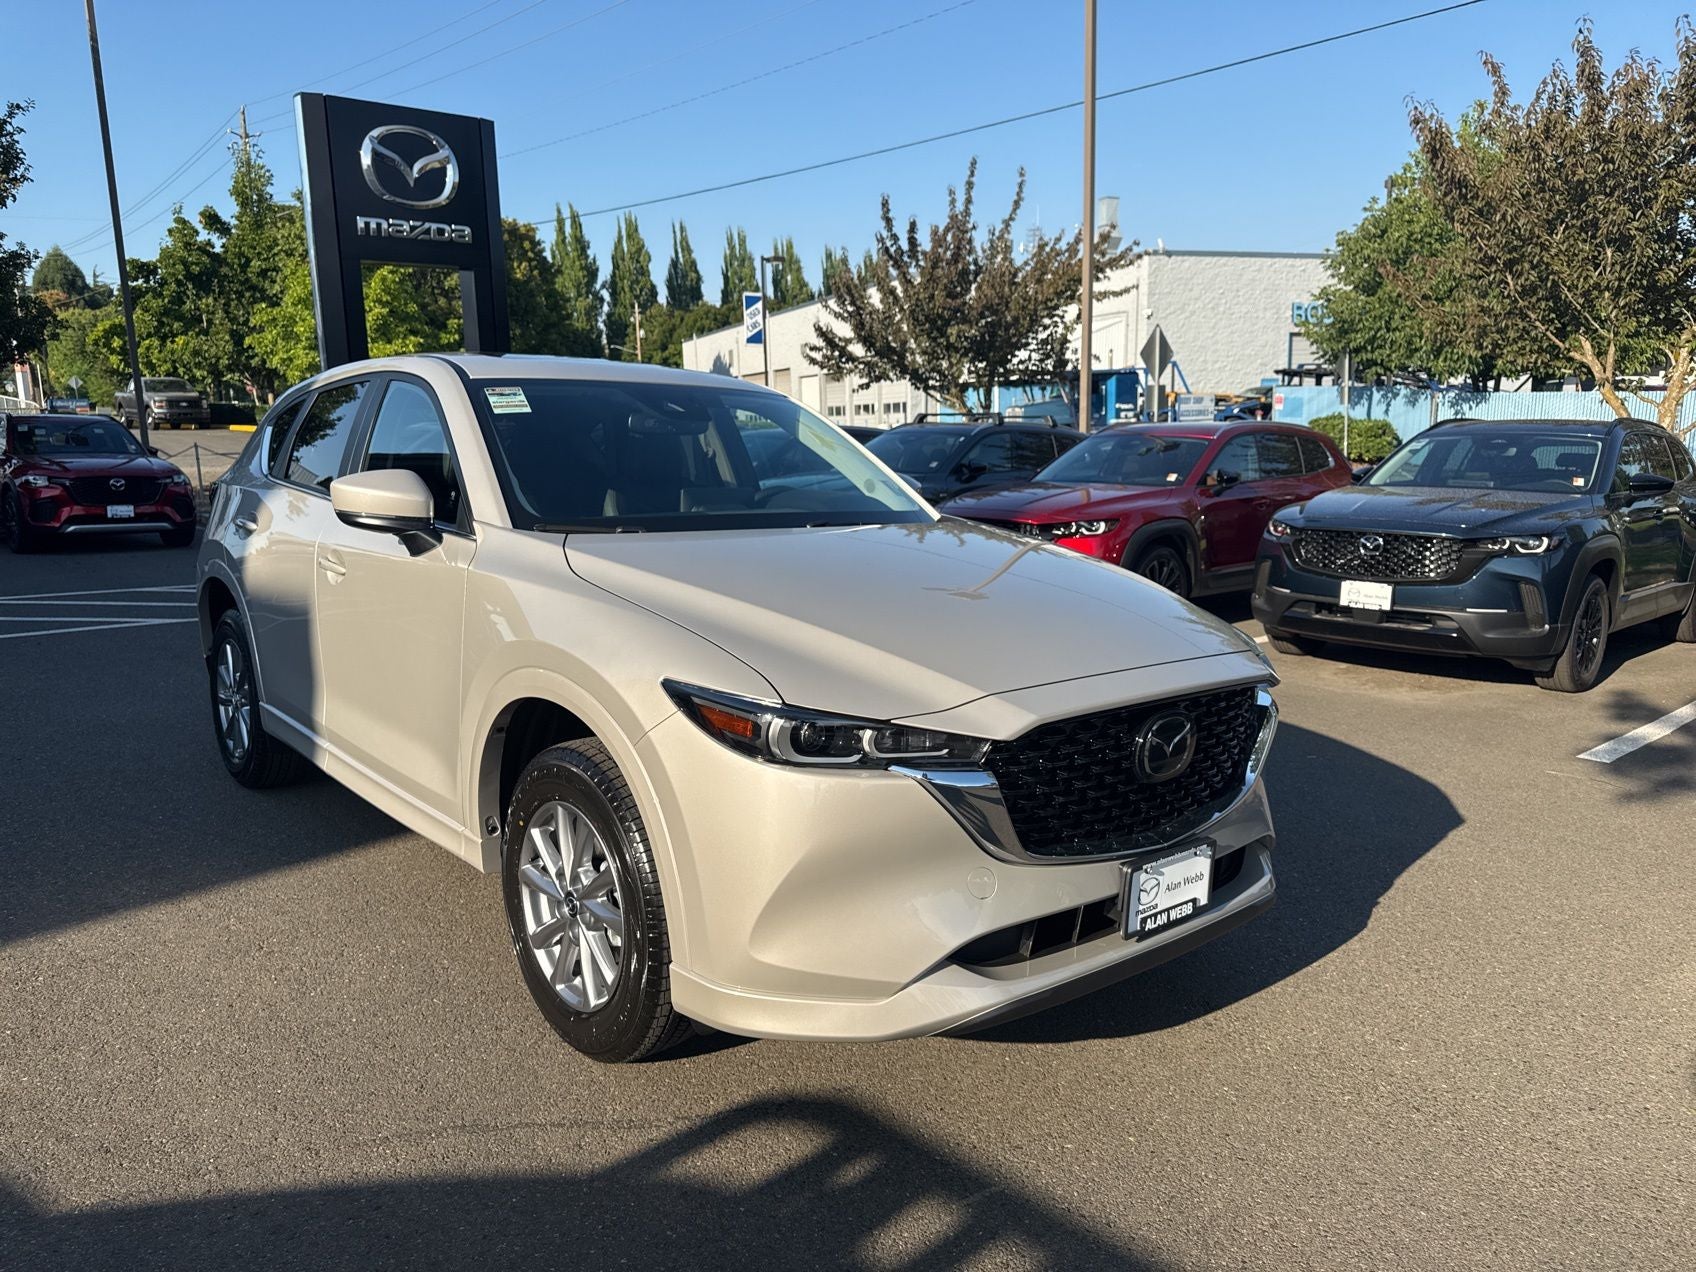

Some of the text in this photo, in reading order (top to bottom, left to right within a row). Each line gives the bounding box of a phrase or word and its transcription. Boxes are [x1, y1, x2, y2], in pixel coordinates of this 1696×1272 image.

[1164, 870, 1205, 894] Alan Webb
[1135, 903, 1159, 917] mazda
[1144, 901, 1193, 931] ALAN WEBB
